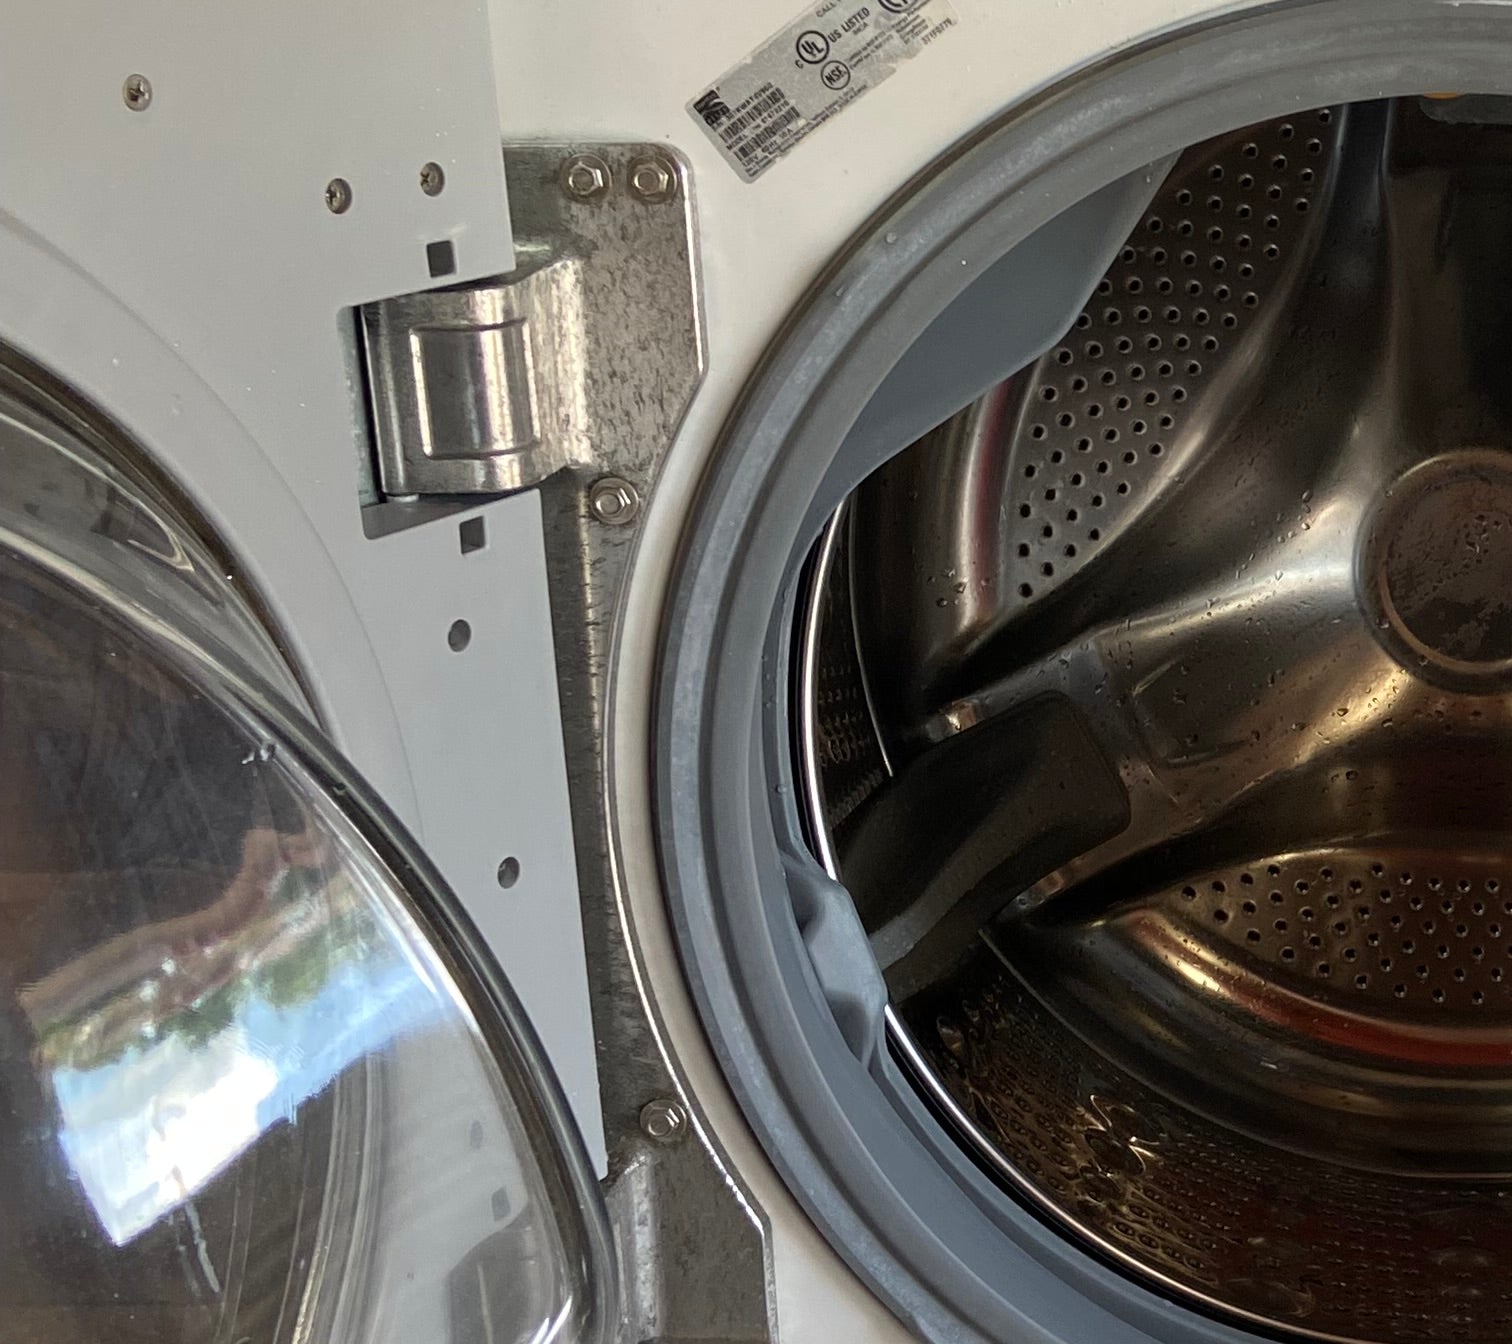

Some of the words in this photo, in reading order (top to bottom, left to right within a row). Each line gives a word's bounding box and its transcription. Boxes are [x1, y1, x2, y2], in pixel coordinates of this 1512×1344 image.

[814, 0, 836, 18] CALL
[826, 28, 842, 43] US
[840, 6, 871, 33] LISTED
